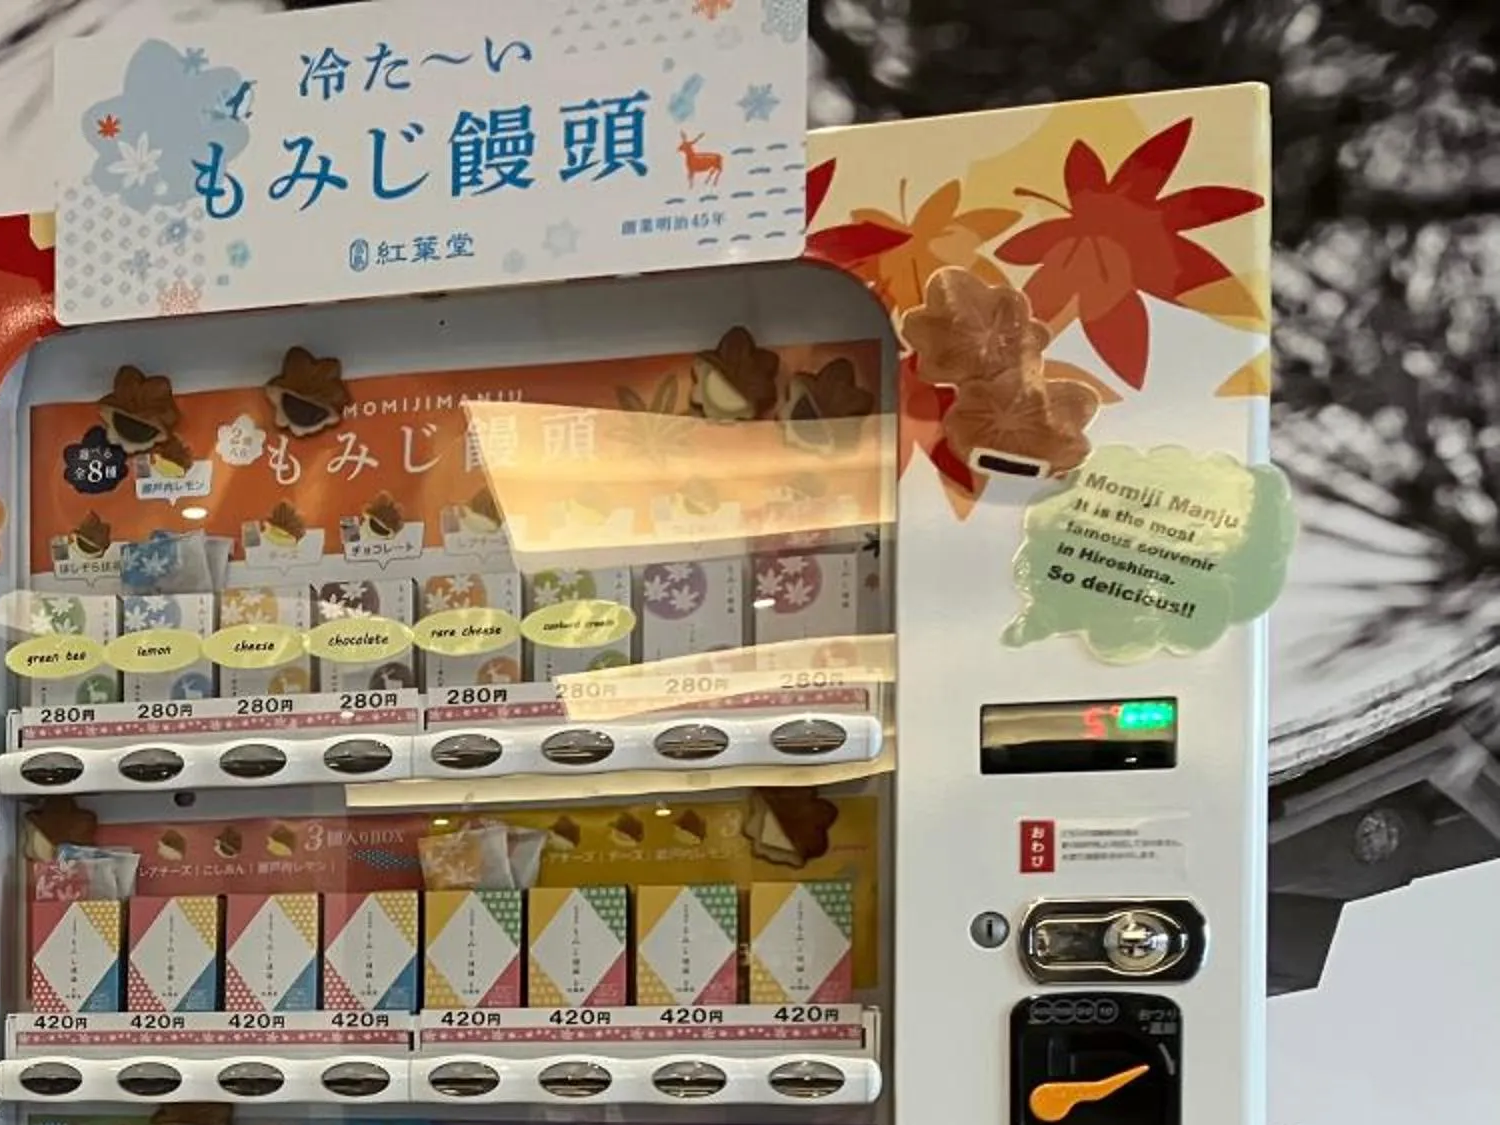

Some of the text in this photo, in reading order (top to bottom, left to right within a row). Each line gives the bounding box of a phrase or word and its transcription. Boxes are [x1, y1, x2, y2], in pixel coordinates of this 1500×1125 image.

[193, 91, 650, 219] もみじ饅頭
[376, 233, 475, 264] 紅葉堂
[1085, 472, 1240, 530] Momiji Manju
[1074, 498, 1197, 543] It is the most
[350, 542, 415, 558] チョコレート
[1066, 520, 1217, 573] famous souvenir
[1056, 542, 1177, 586] in Hiroshima.
[1048, 565, 1197, 619] So delicious!!
[327, 632, 390, 648] chocolate
[430, 624, 503, 639] rare cheese
[136, 644, 172, 658] lemon
[233, 640, 275, 654] cheese
[27, 651, 88, 666] green tea
[665, 676, 729, 694] 280円
[340, 693, 398, 710] 280円
[446, 687, 508, 705] 280円
[41, 707, 95, 722] 280円
[138, 702, 193, 719] 280円
[237, 698, 293, 715] 280円
[34, 1015, 88, 1030] 420円
[130, 1014, 185, 1030] 420円
[228, 1013, 285, 1029] 420円
[331, 1012, 390, 1028] 420円
[441, 1010, 501, 1027] 420円
[549, 1009, 612, 1026] 420円
[660, 1007, 724, 1025] 420円
[774, 1006, 840, 1024] 420円
